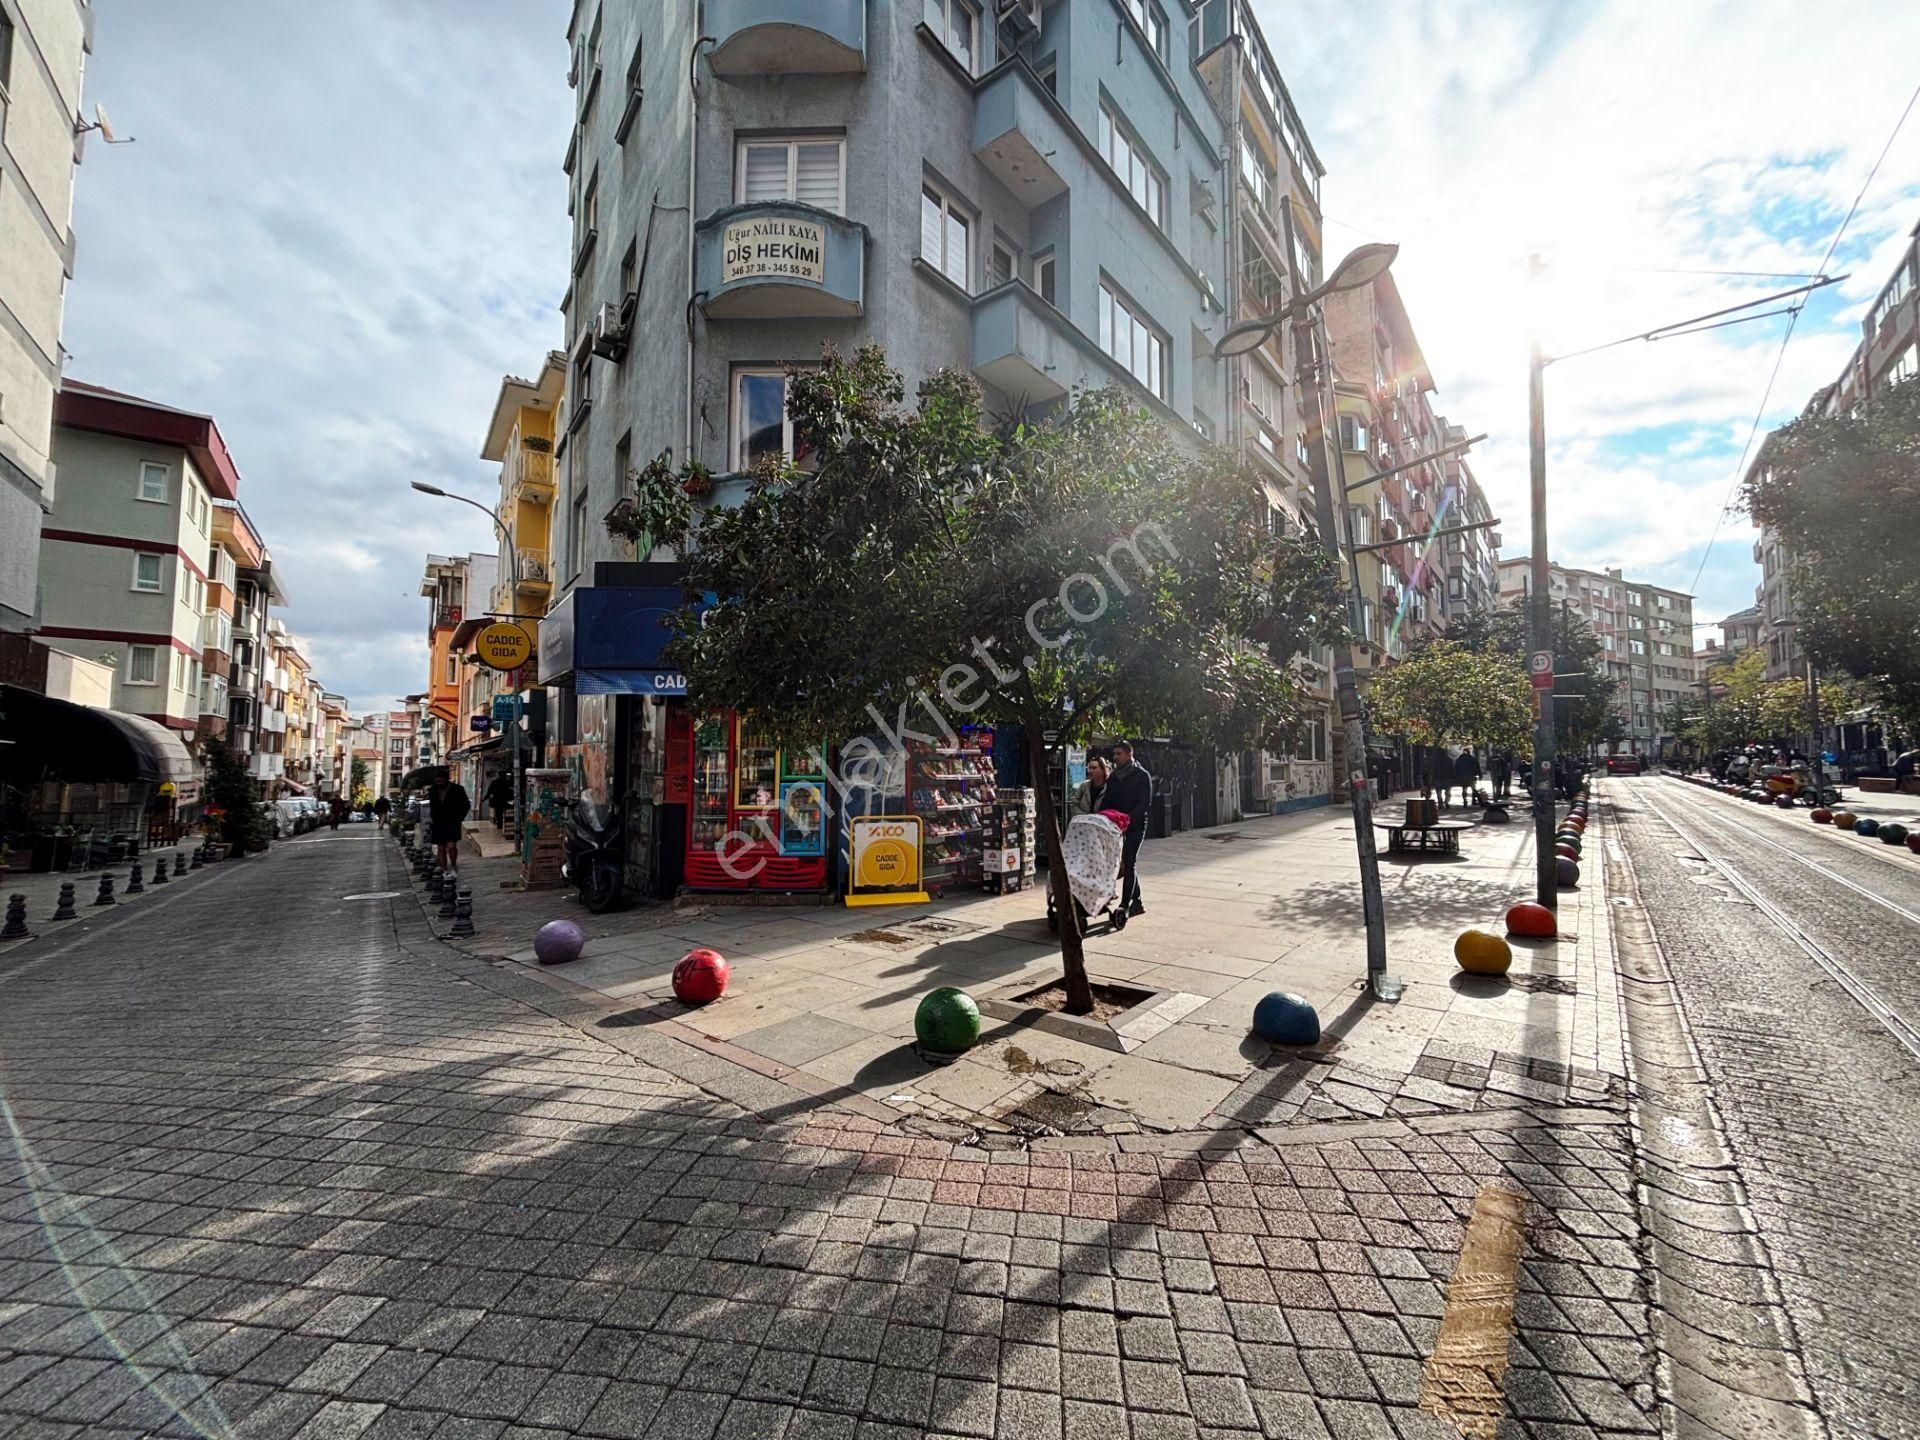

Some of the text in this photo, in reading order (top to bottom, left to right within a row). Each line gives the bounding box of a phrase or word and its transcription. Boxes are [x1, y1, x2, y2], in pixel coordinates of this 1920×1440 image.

[728, 222, 819, 244] Uğur NAİLİ KAYA
[727, 242, 819, 264] DİŞ HEKİMİ
[731, 265, 744, 277] 346
[746, 264, 755, 273] 37
[756, 263, 766, 273] 38
[773, 263, 788, 272] 345
[790, 264, 800, 274] 55
[802, 266, 812, 276] 29
[486, 634, 523, 646] CADDE
[491, 647, 517, 657] GIDA
[654, 674, 688, 689] CAD
[875, 854, 899, 863] CADDE
[878, 863, 896, 871] GIDA
